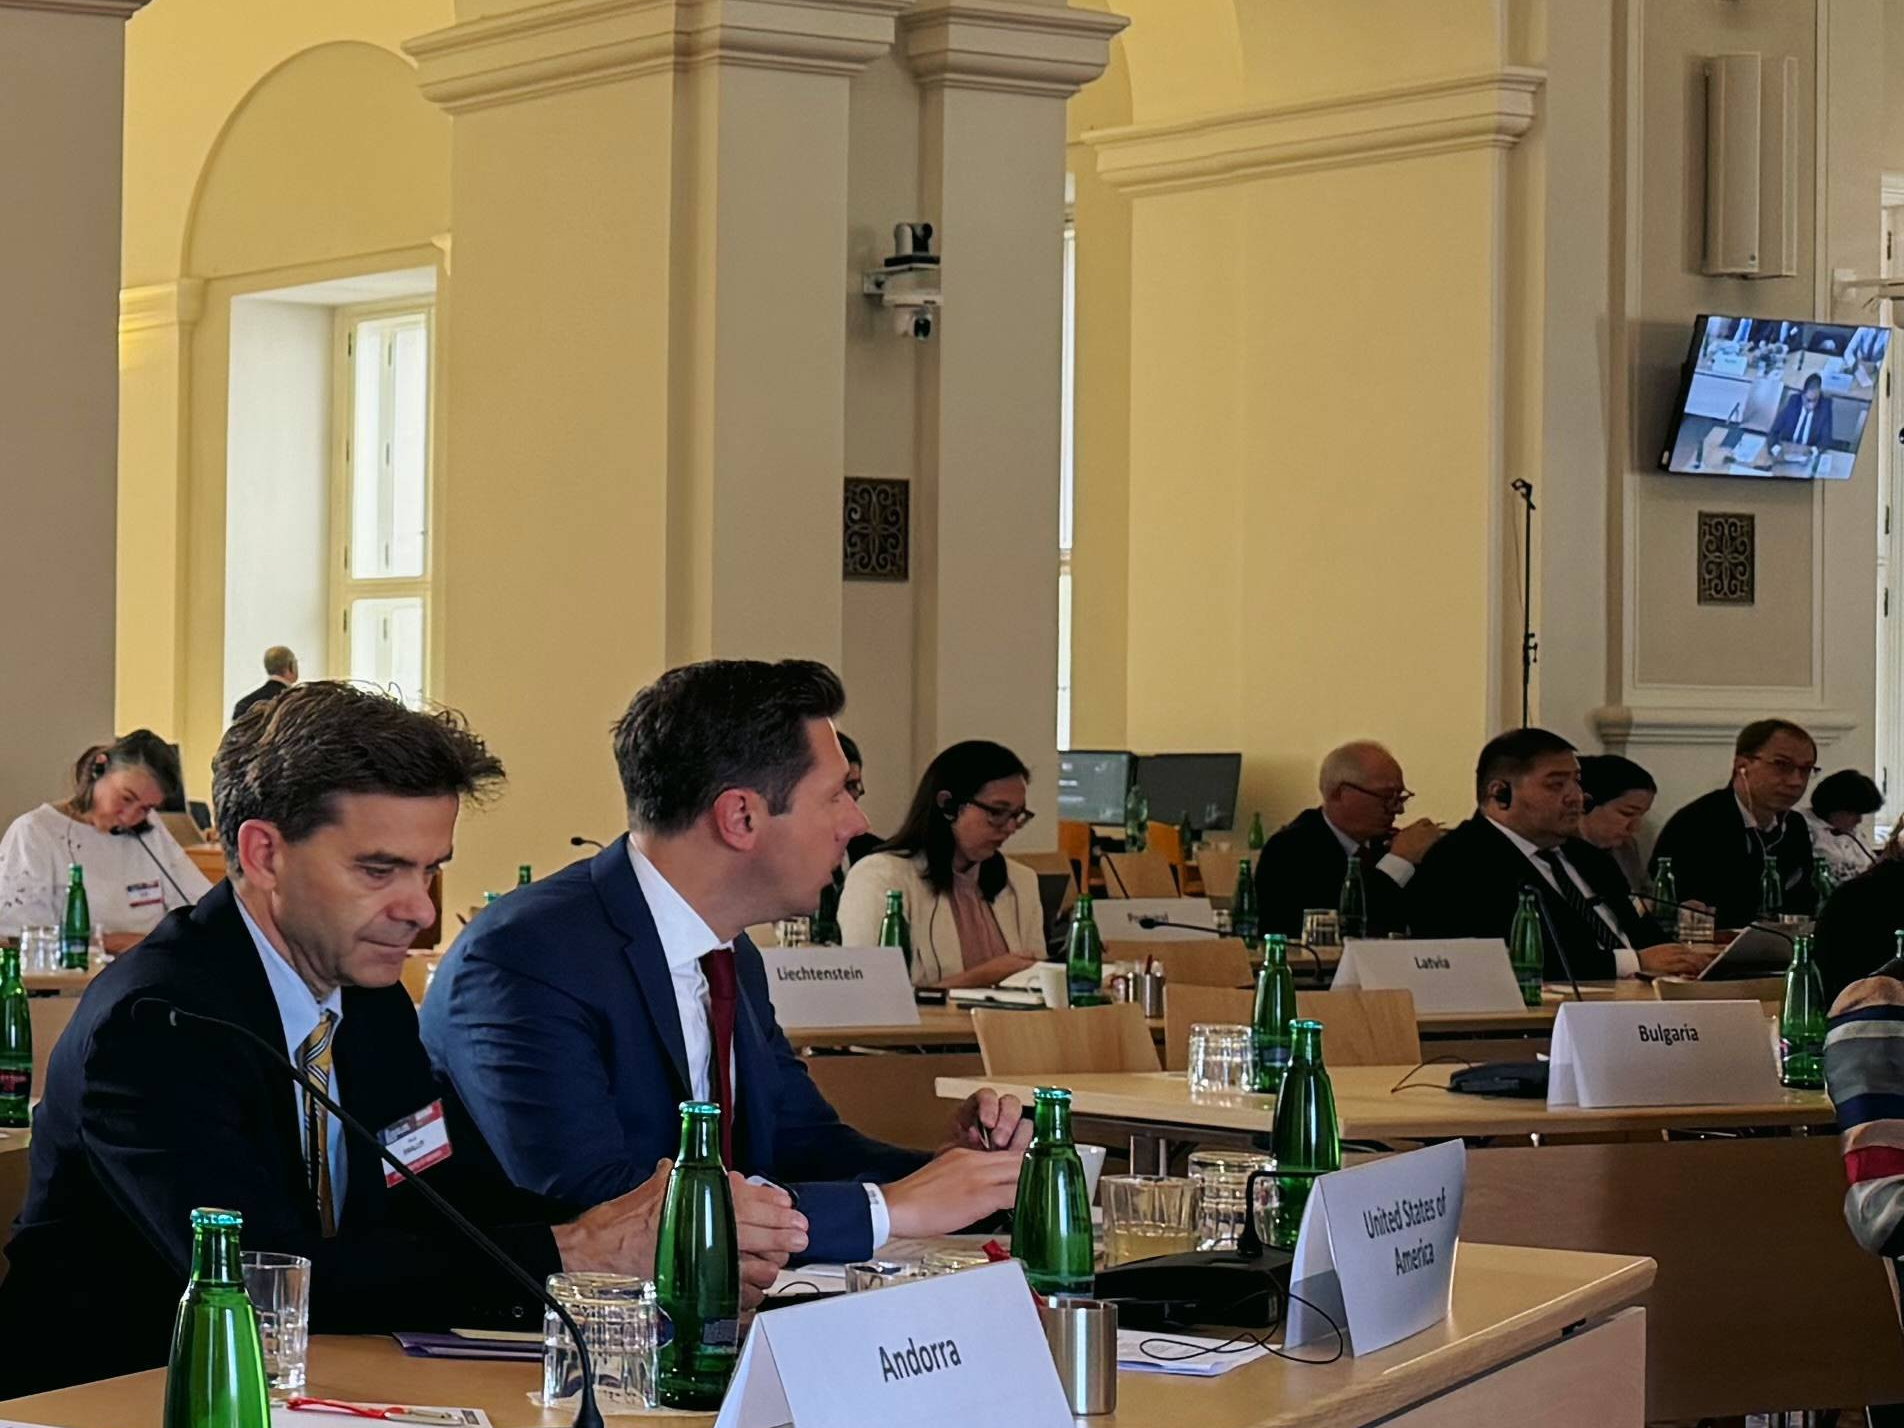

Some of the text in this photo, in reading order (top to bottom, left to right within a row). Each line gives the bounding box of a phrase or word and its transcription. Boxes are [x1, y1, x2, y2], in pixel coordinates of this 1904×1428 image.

[776, 965, 864, 981] Liechtenstein
[1638, 1022, 1700, 1046] Bulgaria
[1362, 1186, 1446, 1239] United States of
[1394, 1237, 1435, 1277] America
[878, 1336, 962, 1384] Andorra
